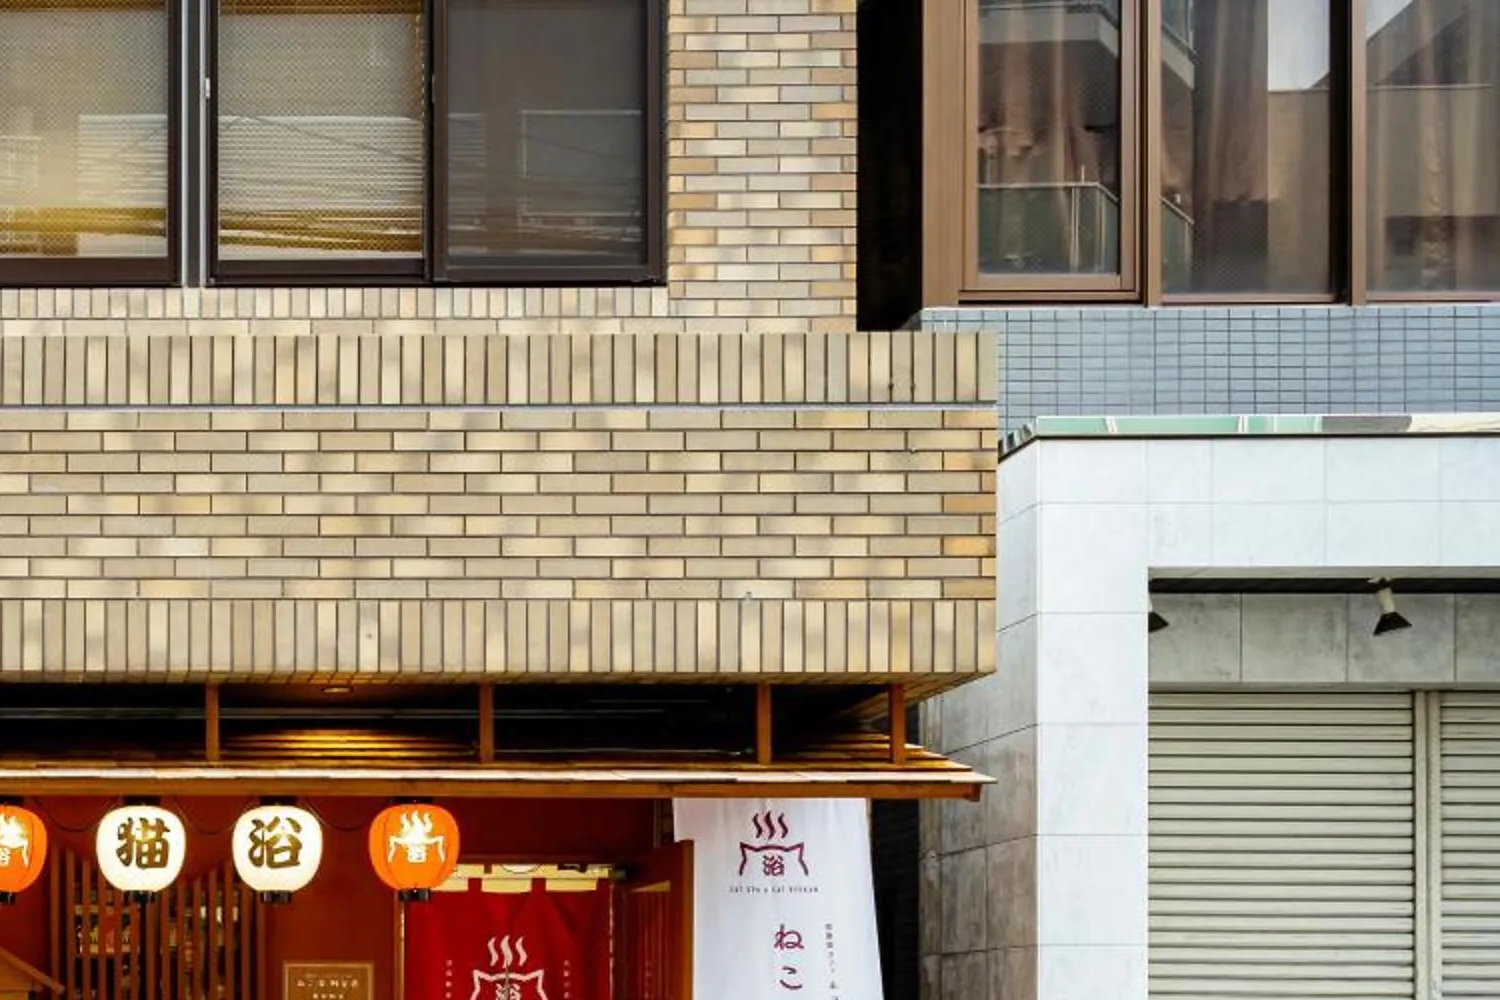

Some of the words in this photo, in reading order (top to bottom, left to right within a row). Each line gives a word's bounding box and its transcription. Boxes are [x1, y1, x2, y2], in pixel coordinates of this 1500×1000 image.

[116, 817, 171, 869] 猫
[249, 817, 304, 869] 浴
[762, 854, 785, 876] 浴
